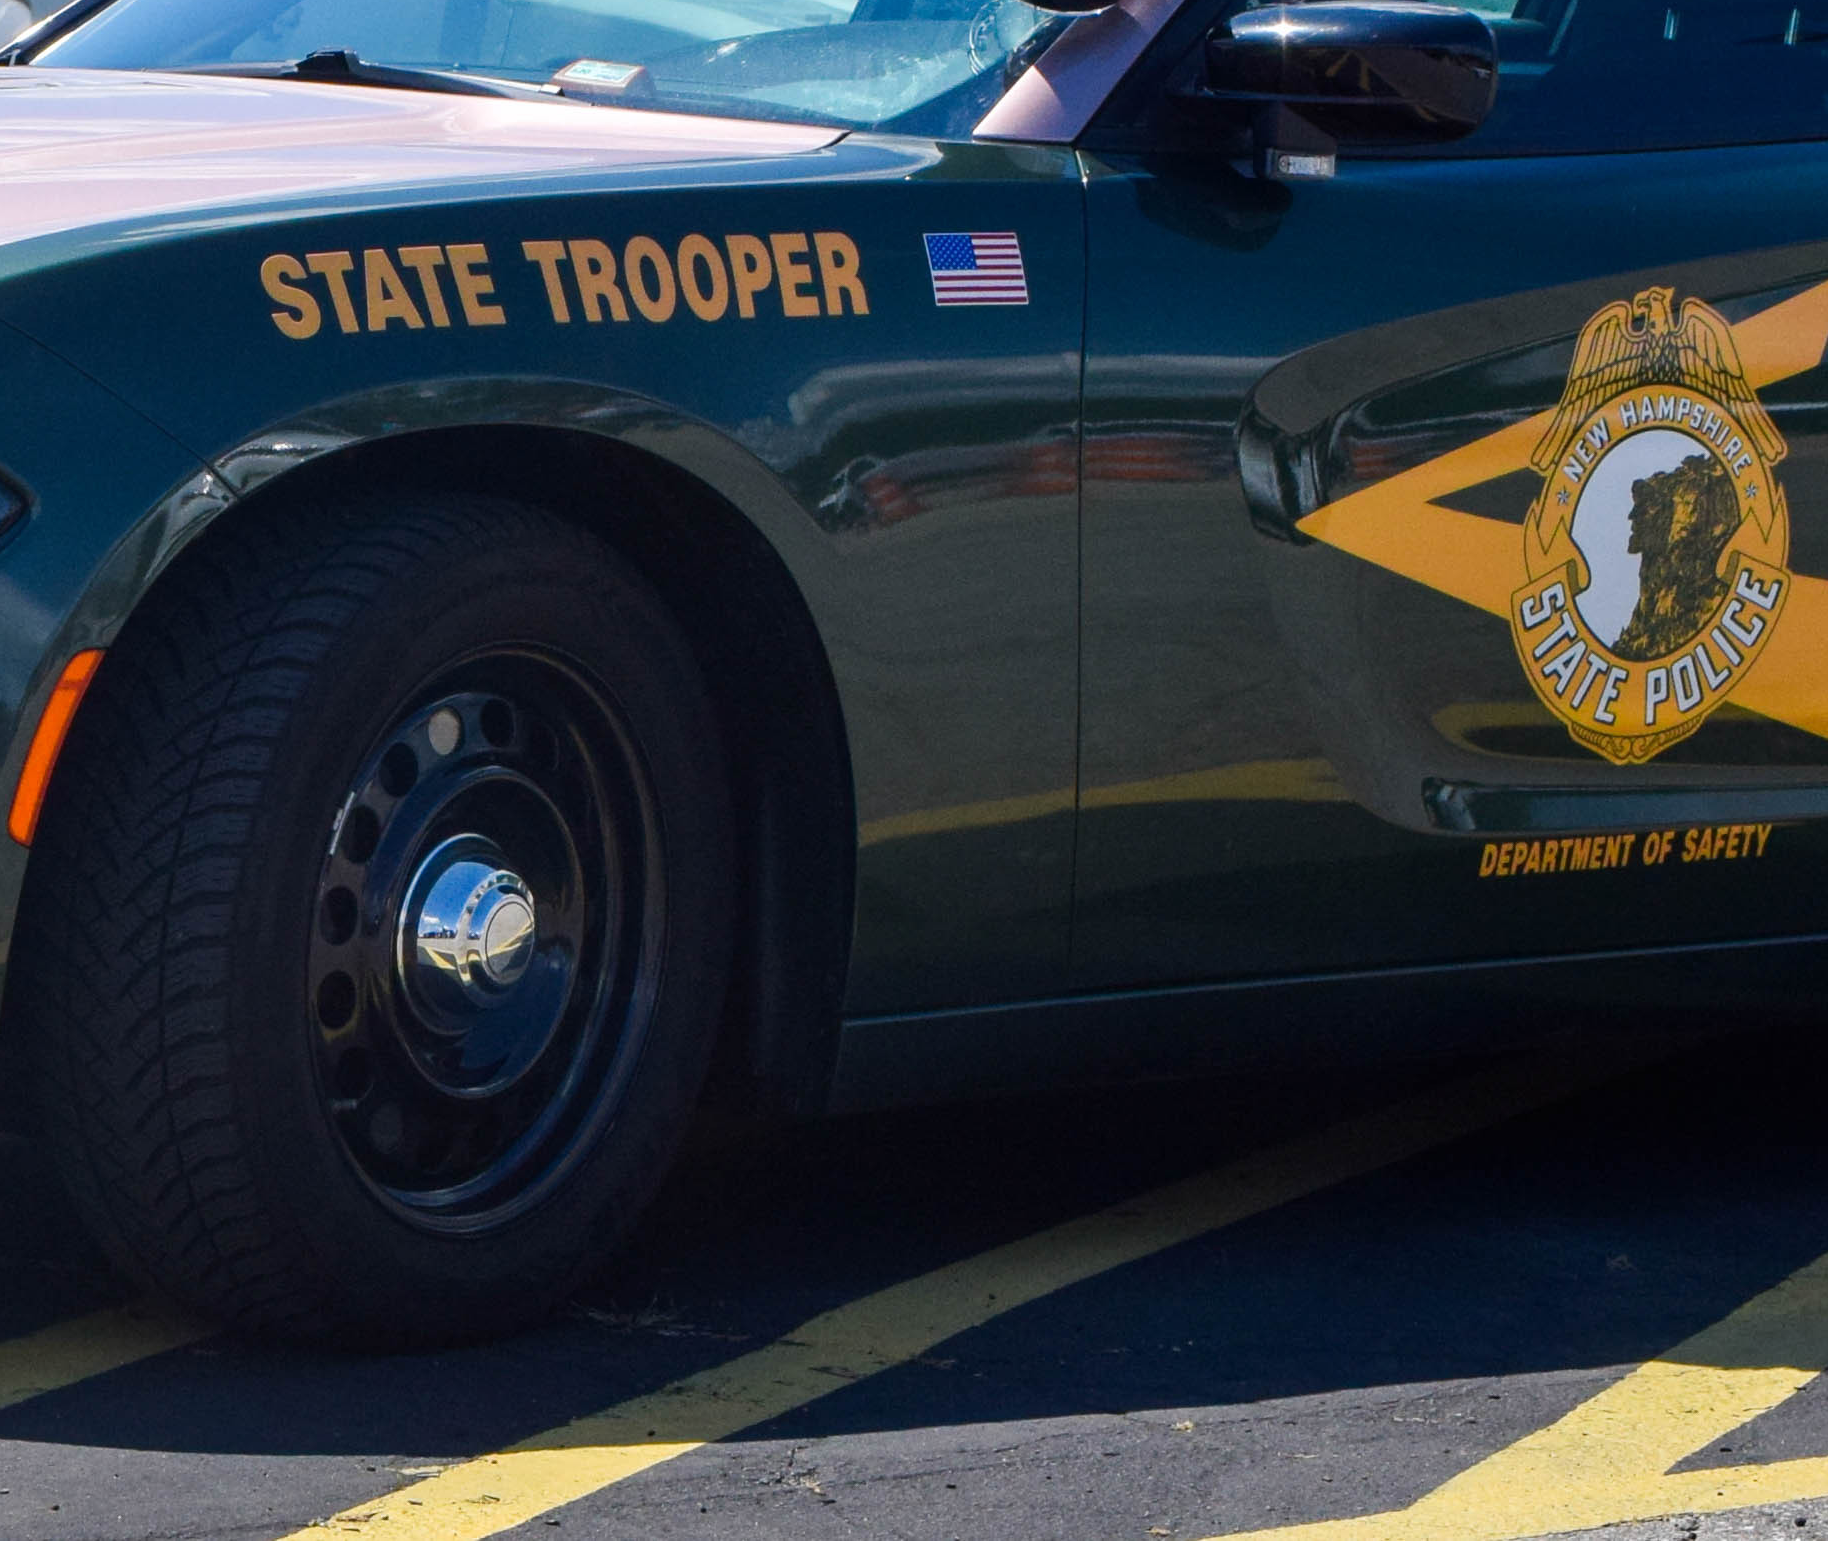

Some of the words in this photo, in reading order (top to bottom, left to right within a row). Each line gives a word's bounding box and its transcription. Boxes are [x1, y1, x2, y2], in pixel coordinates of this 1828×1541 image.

[261, 243, 506, 340] STATE
[521, 232, 870, 325] TROOPER
[1562, 417, 1611, 483] NEW
[1619, 394, 1753, 477] HAMPSHIRE
[1520, 581, 1630, 726] STATE
[1644, 568, 1783, 726] POLICE
[1479, 834, 1636, 878] DEPARTMENT
[1642, 831, 1675, 866] OF
[1682, 823, 1772, 863] SAFETY
